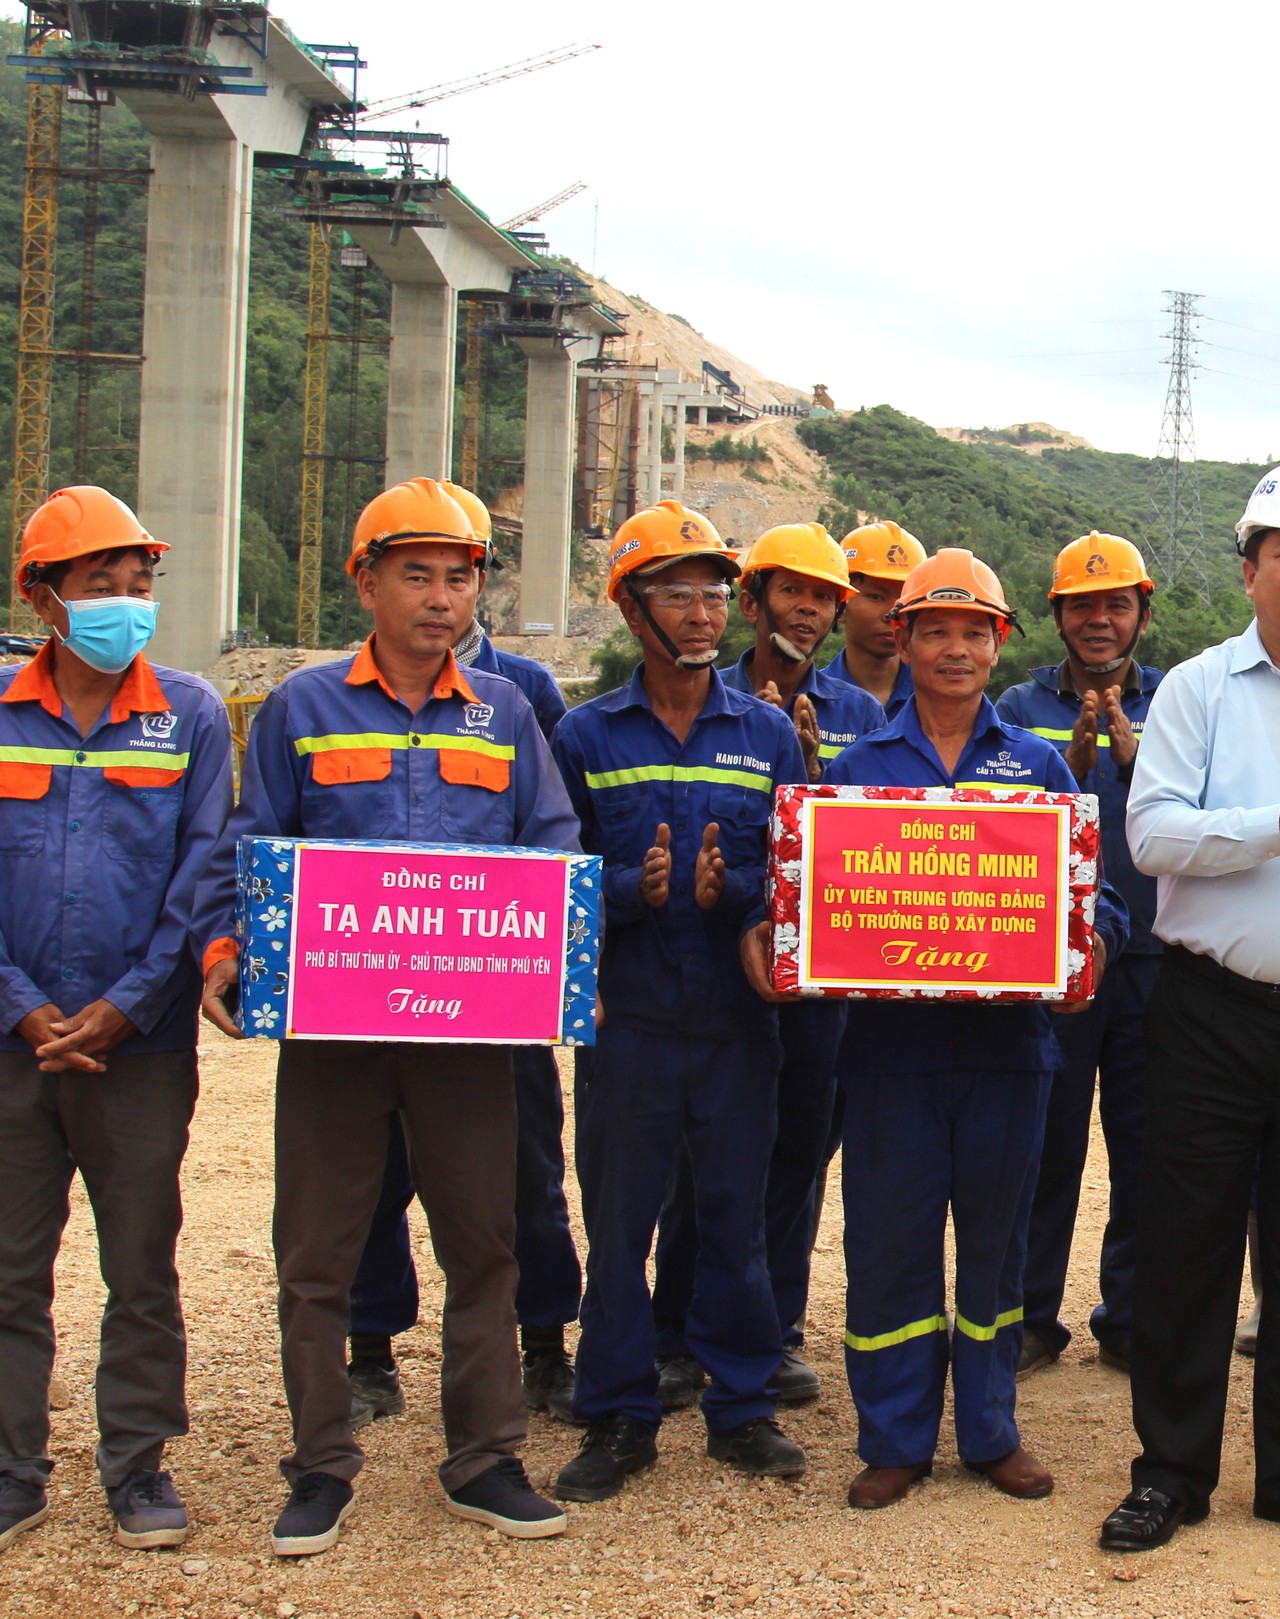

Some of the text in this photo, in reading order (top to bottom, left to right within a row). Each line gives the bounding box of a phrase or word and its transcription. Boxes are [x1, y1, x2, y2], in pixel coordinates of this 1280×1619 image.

[130, 739, 177, 750] THĂNG LONG
[829, 732, 856, 742] INCONS
[716, 752, 770, 772] HANOI INCONS
[1015, 769, 1032, 777] LONG
[900, 818, 976, 841] ĐỒNG CHÍ
[841, 843, 1038, 878] TRẦN HỒNG MINH
[381, 867, 487, 891] ĐỒNG CHÍ
[824, 883, 1046, 909] ỦY VIÊN TRUNG ƯƠNG ĐẢNG
[318, 900, 546, 939] TẠ ANH TUẤN
[830, 910, 1036, 936] BỘ TRƯỞNG BỘ XÂY DỰNG
[305, 949, 325, 967] PHÓ
[328, 949, 339, 968] BÍ
[341, 951, 361, 968] THƯ
[362, 949, 385, 969] TỈNH
[388, 950, 400, 970] ỦY
[410, 951, 430, 971] CHỦ
[433, 955, 454, 974] TỊCH
[457, 956, 483, 973] UBND
[486, 953, 508, 973] TỈNH
[511, 956, 530, 974] PHÚ
[533, 956, 551, 974] YÊN
[881, 940, 992, 973] Tặng
[387, 988, 463, 1020] Tặng
